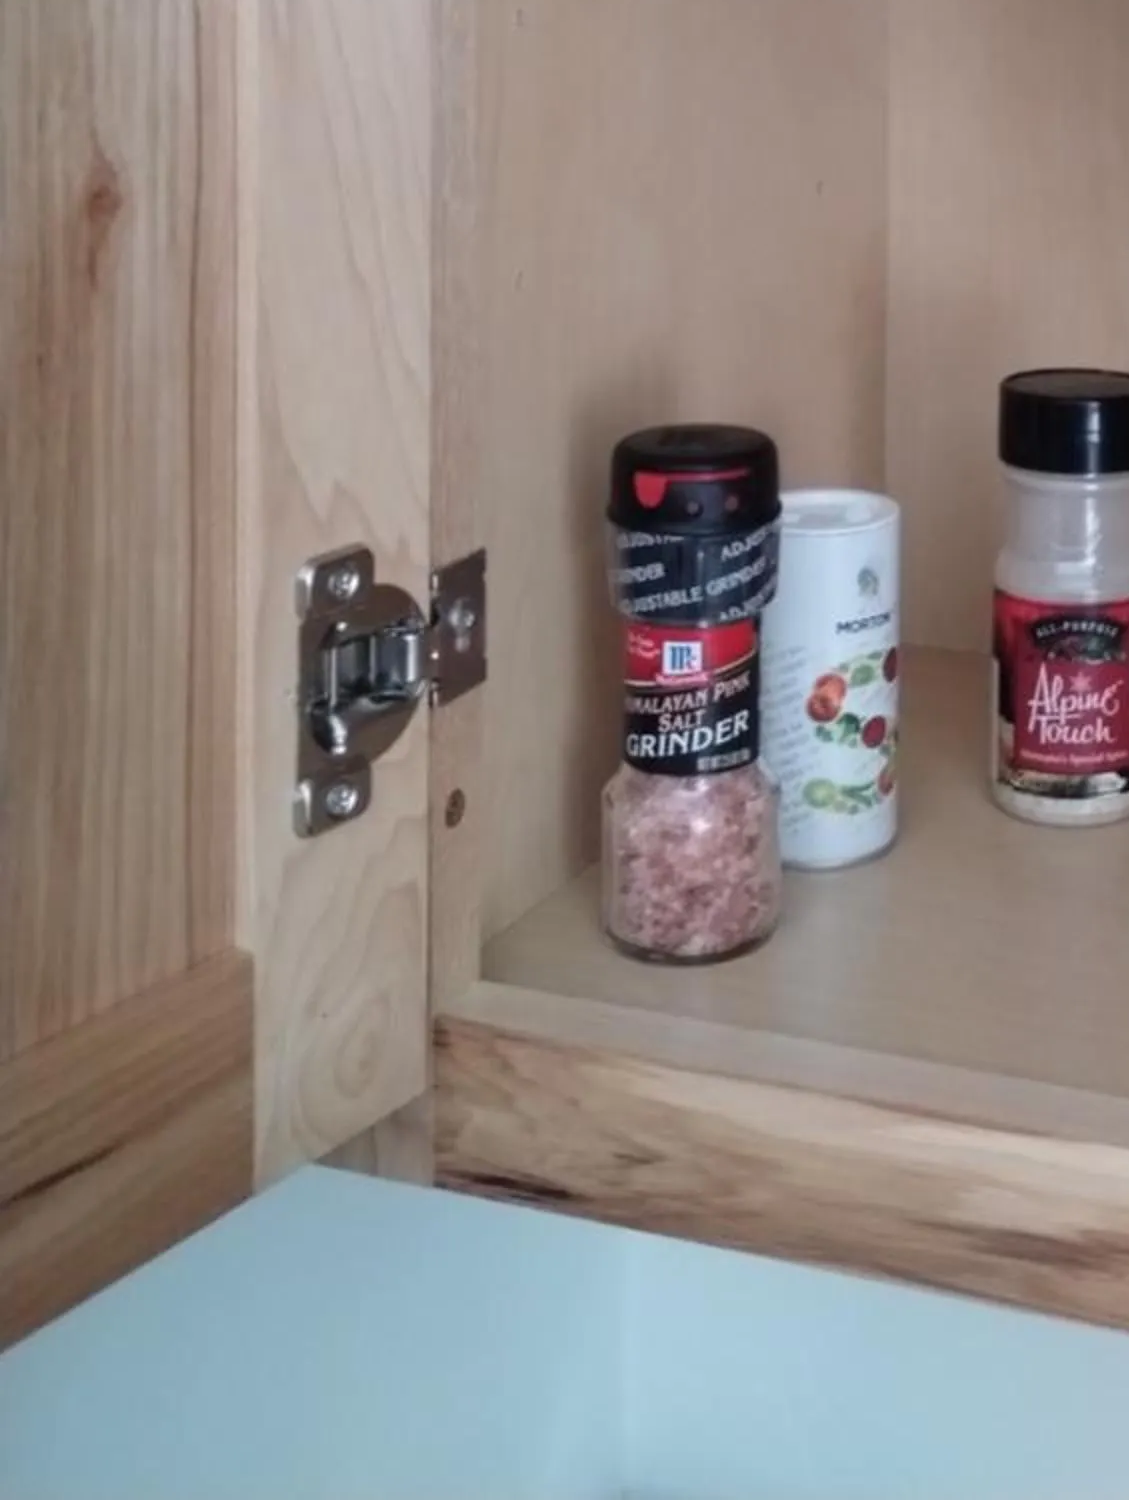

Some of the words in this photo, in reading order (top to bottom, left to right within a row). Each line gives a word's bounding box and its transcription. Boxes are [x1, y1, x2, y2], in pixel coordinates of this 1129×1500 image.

[1027, 661, 1124, 734] Alpine
[625, 708, 750, 758] GRINDER
[658, 709, 706, 733] SALT
[1034, 716, 1117, 745] Touch
